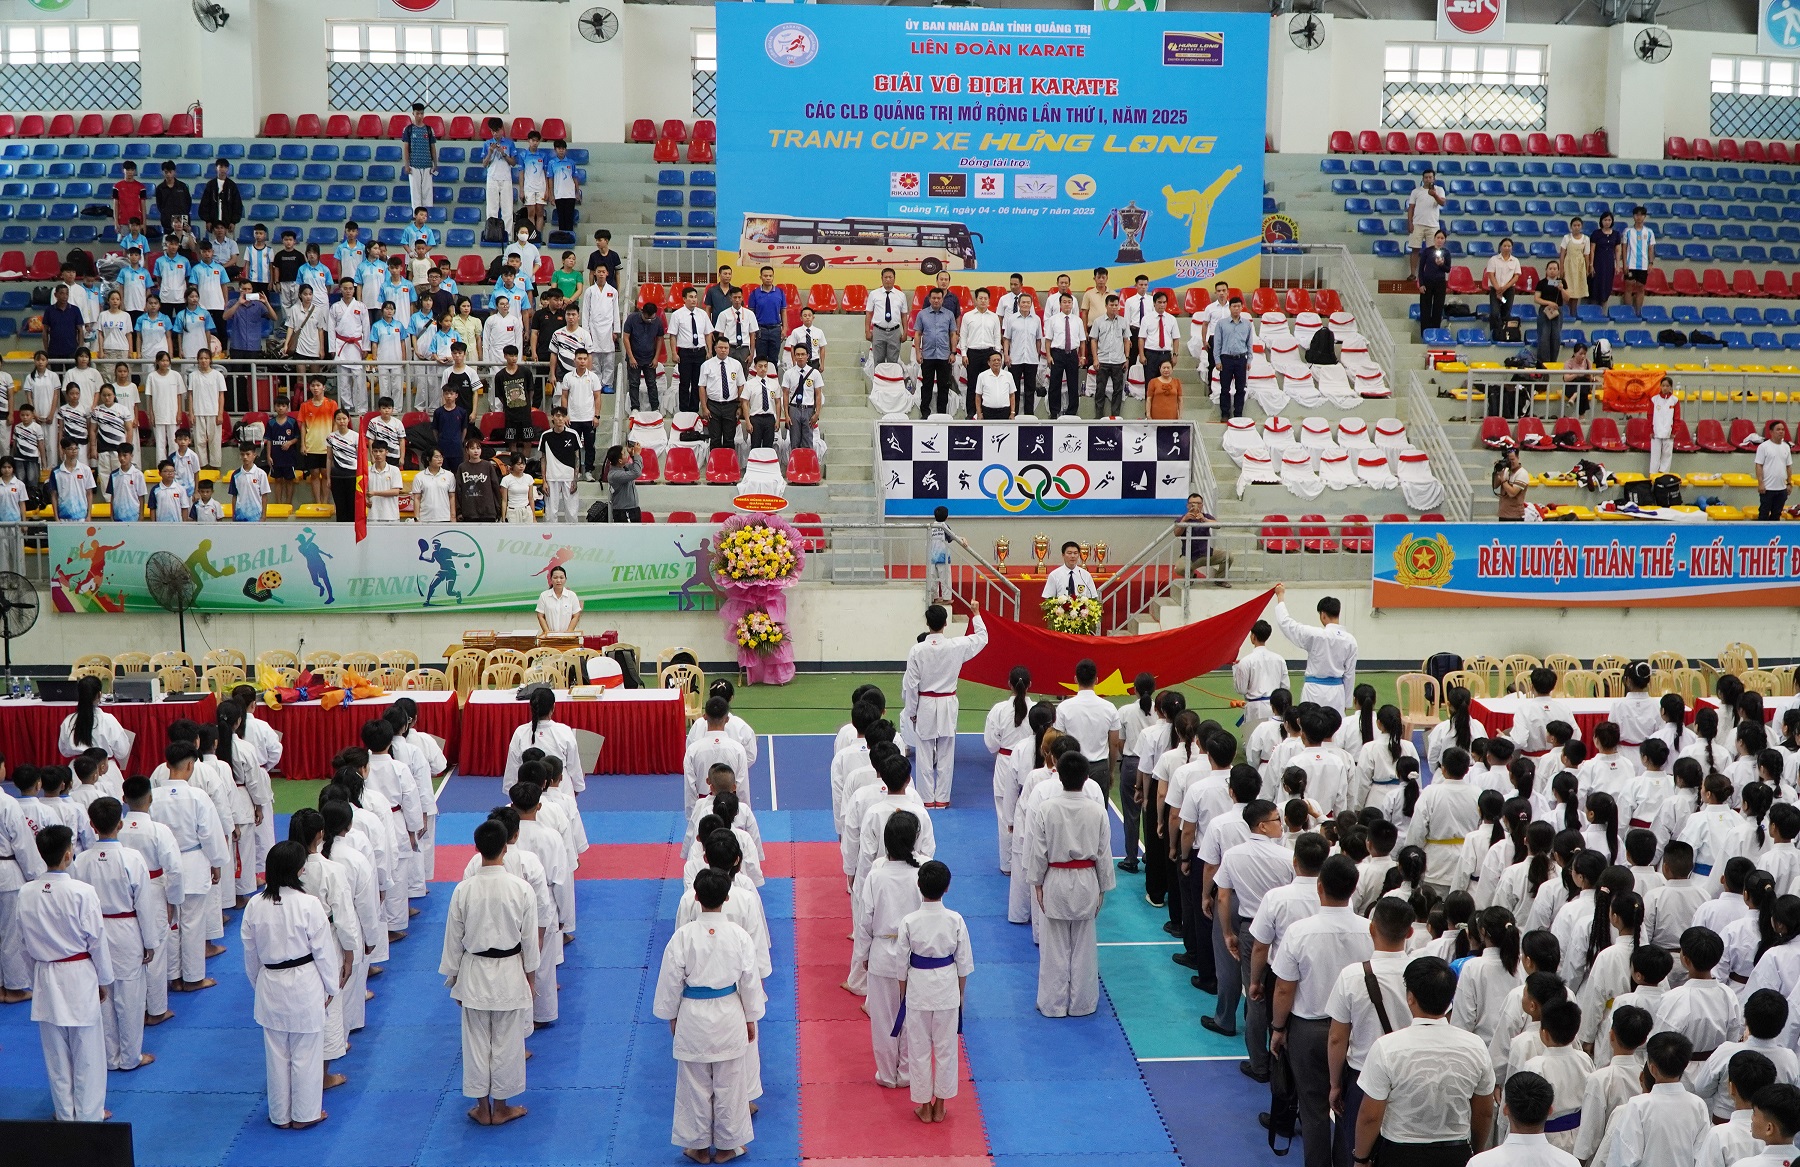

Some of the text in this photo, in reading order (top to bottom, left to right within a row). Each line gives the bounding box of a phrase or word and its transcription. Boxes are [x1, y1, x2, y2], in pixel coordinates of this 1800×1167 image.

[906, 18, 1091, 35] ỦY BAN NHÂN DÂN TỈNH QUẢNG TRỊ
[911, 38, 1085, 57] LIÊN ĐOÀN KARATE
[874, 72, 1119, 96] GIẢI VÔ ĐỊCH KARATE
[805, 100, 1188, 126] CÁC CLB QUẢNG TRỊ MỞ RỘNG LẦN THỨ I, NĂM 2025
[769, 127, 1218, 154] TRANH CÚP XE HƯNG LONG
[959, 156, 990, 168] Đồng
[992, 158, 1007, 168] tài
[899, 205, 931, 214] Quảng
[935, 205, 950, 214] Trị,
[952, 206, 976, 215] ngày
[1012, 207, 1039, 216] tháng
[1175, 259, 1218, 268] KARATE
[1176, 268, 1216, 278] 2025
[496, 538, 616, 564] VOLLEBALL
[1478, 538, 1516, 578] RÈN
[1520, 538, 1578, 584] LUYỆN
[1582, 538, 1636, 578] THÂN
[1640, 534, 1677, 578] THỂ
[1678, 562, 1686, 571] -
[1690, 536, 1735, 578] KIẾN
[1738, 536, 1789, 578] THIẾT
[611, 562, 680, 582] TENNIS
[347, 575, 428, 596] TENNIS
